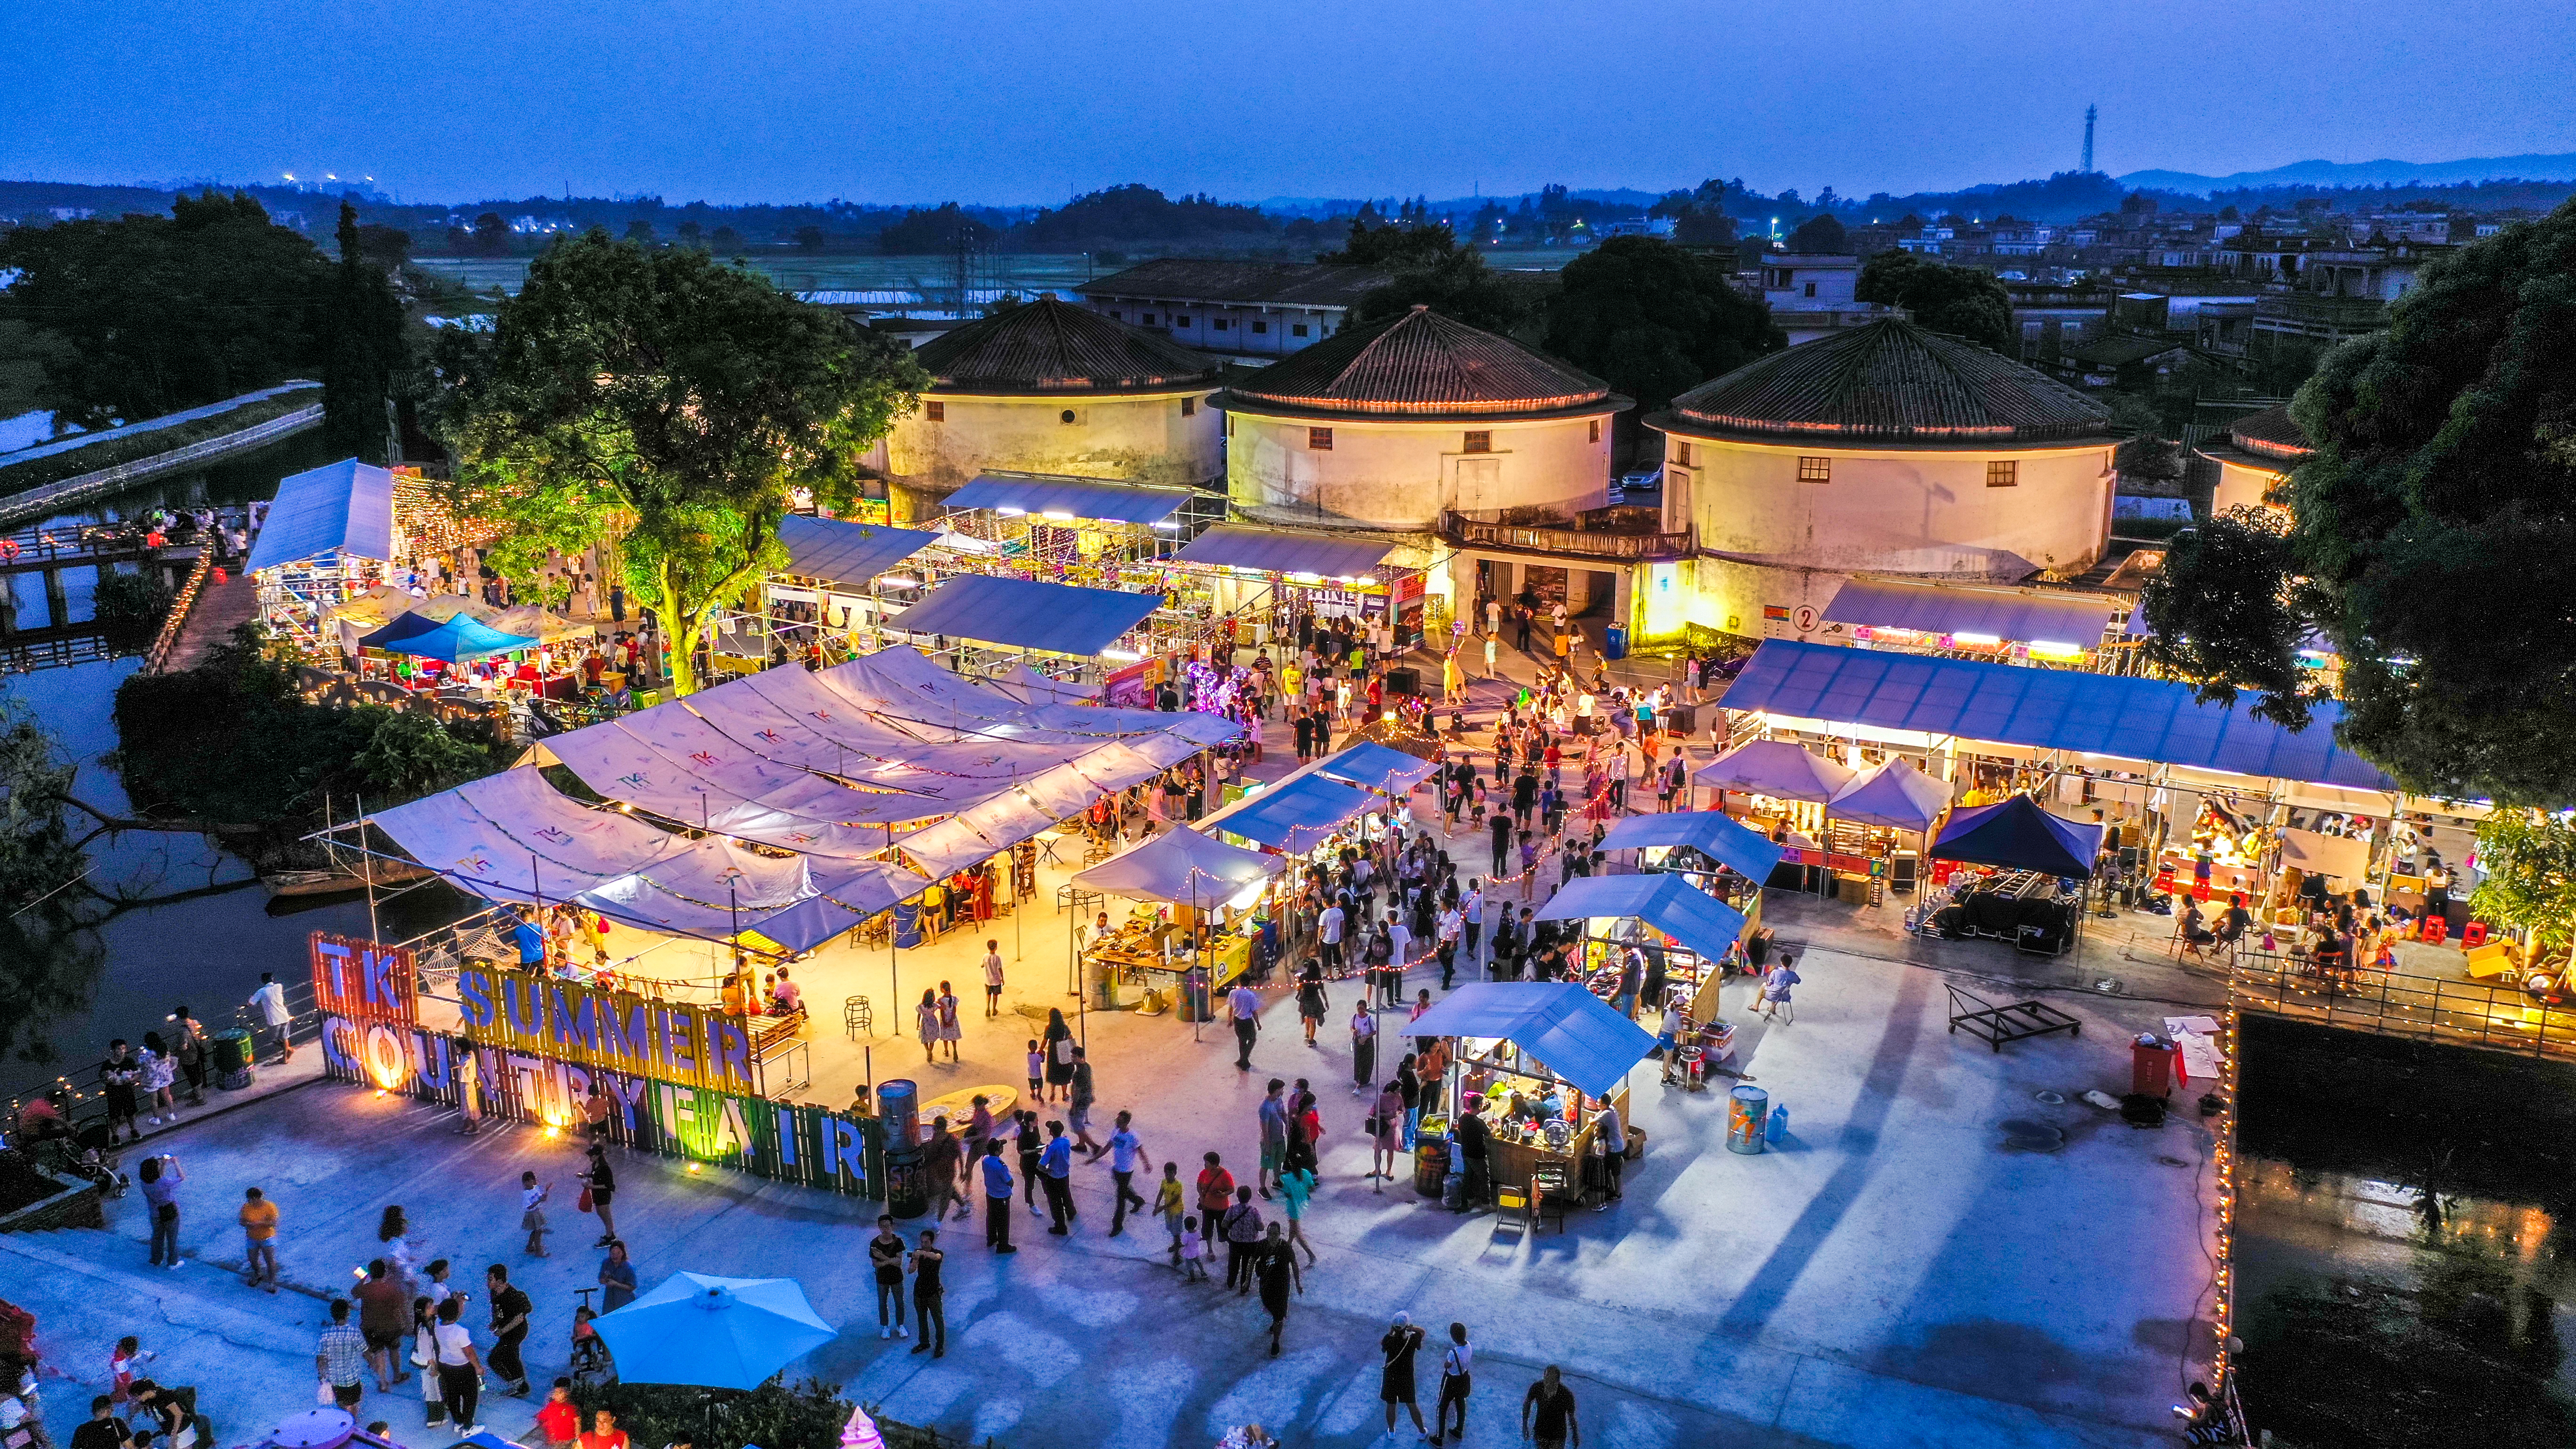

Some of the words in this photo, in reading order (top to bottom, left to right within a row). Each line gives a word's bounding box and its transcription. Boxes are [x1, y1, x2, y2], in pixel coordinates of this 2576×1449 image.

[1802, 610, 1811, 627] 2
[1145, 670, 1154, 679] 工艺
[317, 942, 401, 1009] TK
[459, 971, 752, 1083] SUMMER
[659, 1081, 866, 1180] FAIR
